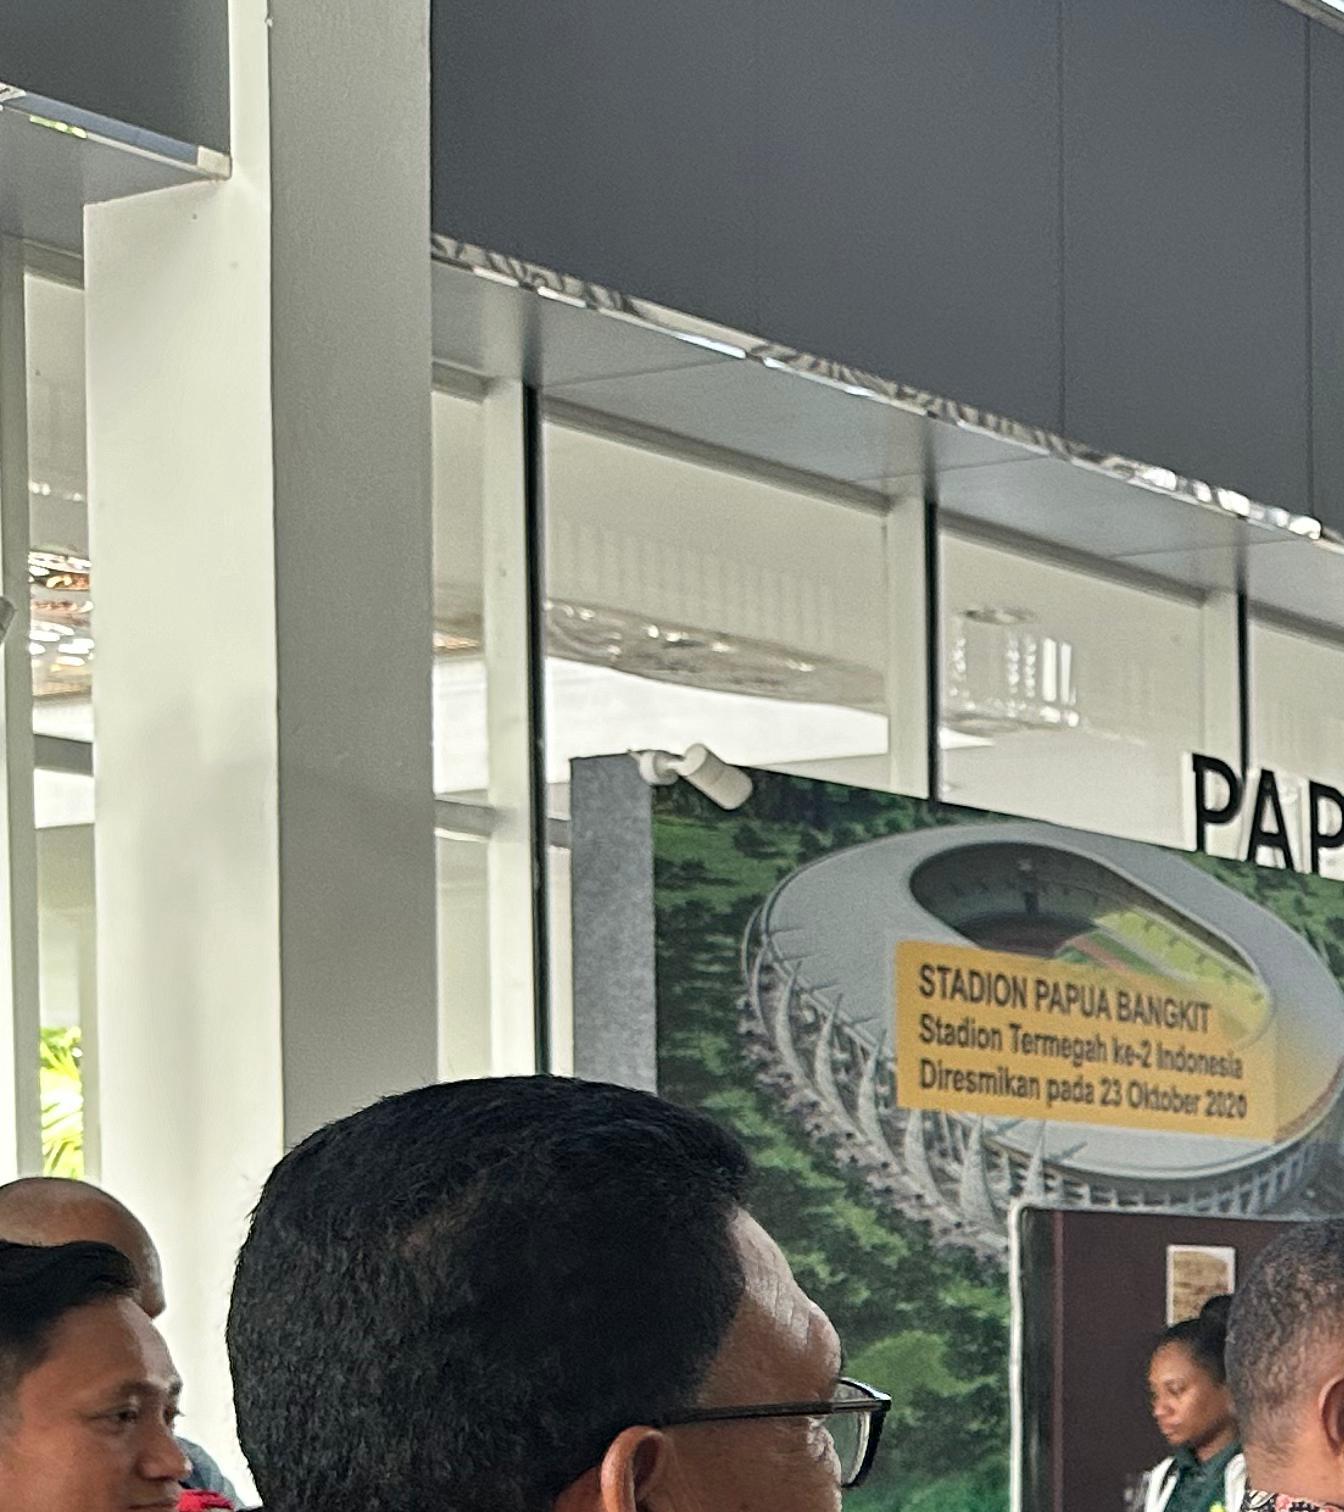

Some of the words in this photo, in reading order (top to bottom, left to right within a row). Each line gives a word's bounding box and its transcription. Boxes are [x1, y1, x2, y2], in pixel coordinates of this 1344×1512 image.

[919, 963, 1028, 1009] STADION
[1035, 978, 1112, 1021] PAPUA
[1117, 989, 1212, 1034] BANGKIT
[919, 1013, 1003, 1051] Stadion
[1009, 1022, 1108, 1068] Termegah
[1112, 1036, 1153, 1069] ke-2
[1156, 1040, 1244, 1080] Indonesia
[919, 1057, 1041, 1100] Diresmikan
[1046, 1073, 1096, 1109] pada
[1100, 1077, 1123, 1107] 23
[1127, 1079, 1201, 1114] Oktober
[1205, 1089, 1248, 1119] 2020
